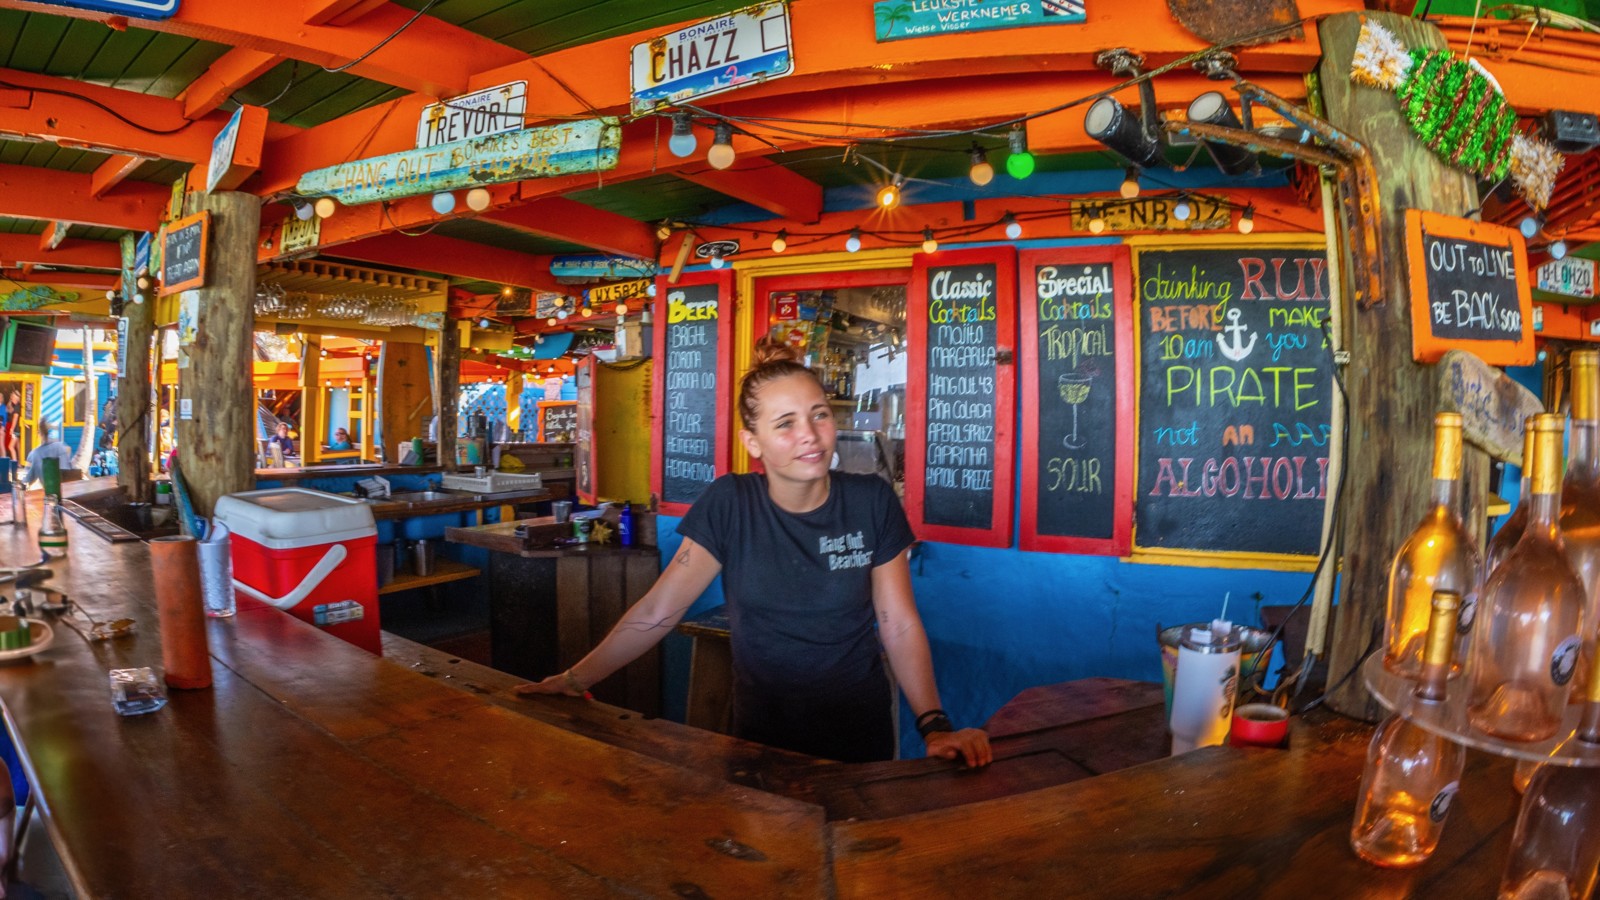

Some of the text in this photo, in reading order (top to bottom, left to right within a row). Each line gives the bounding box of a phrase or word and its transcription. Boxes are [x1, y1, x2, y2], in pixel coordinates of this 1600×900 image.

[937, 3, 1032, 22] WERKNEMER
[679, 18, 736, 41] BONAIRE
[652, 28, 740, 83] CHAZZ
[453, 93, 492, 110] BONAIRE
[426, 102, 501, 147] TREVOR
[530, 126, 572, 149] BEST
[1430, 241, 1467, 273] OUT
[930, 270, 993, 300] Classic
[1144, 262, 1234, 323] drinking
[1150, 303, 1332, 333] BEFORE MAKE
[1432, 301, 1452, 325] BE
[1452, 289, 1500, 331] BACK
[1040, 323, 1113, 369] TROPICAL
[1265, 332, 1307, 363] you
[668, 350, 702, 370] CORONA
[666, 370, 699, 390] CORONA
[1166, 365, 1320, 412] PIRATE
[669, 391, 689, 410] SOL
[952, 400, 992, 420] COLADA
[669, 410, 702, 433] POLAR
[928, 422, 963, 443] APEROL
[1153, 420, 1200, 446] not
[819, 530, 865, 554] Hang Out
